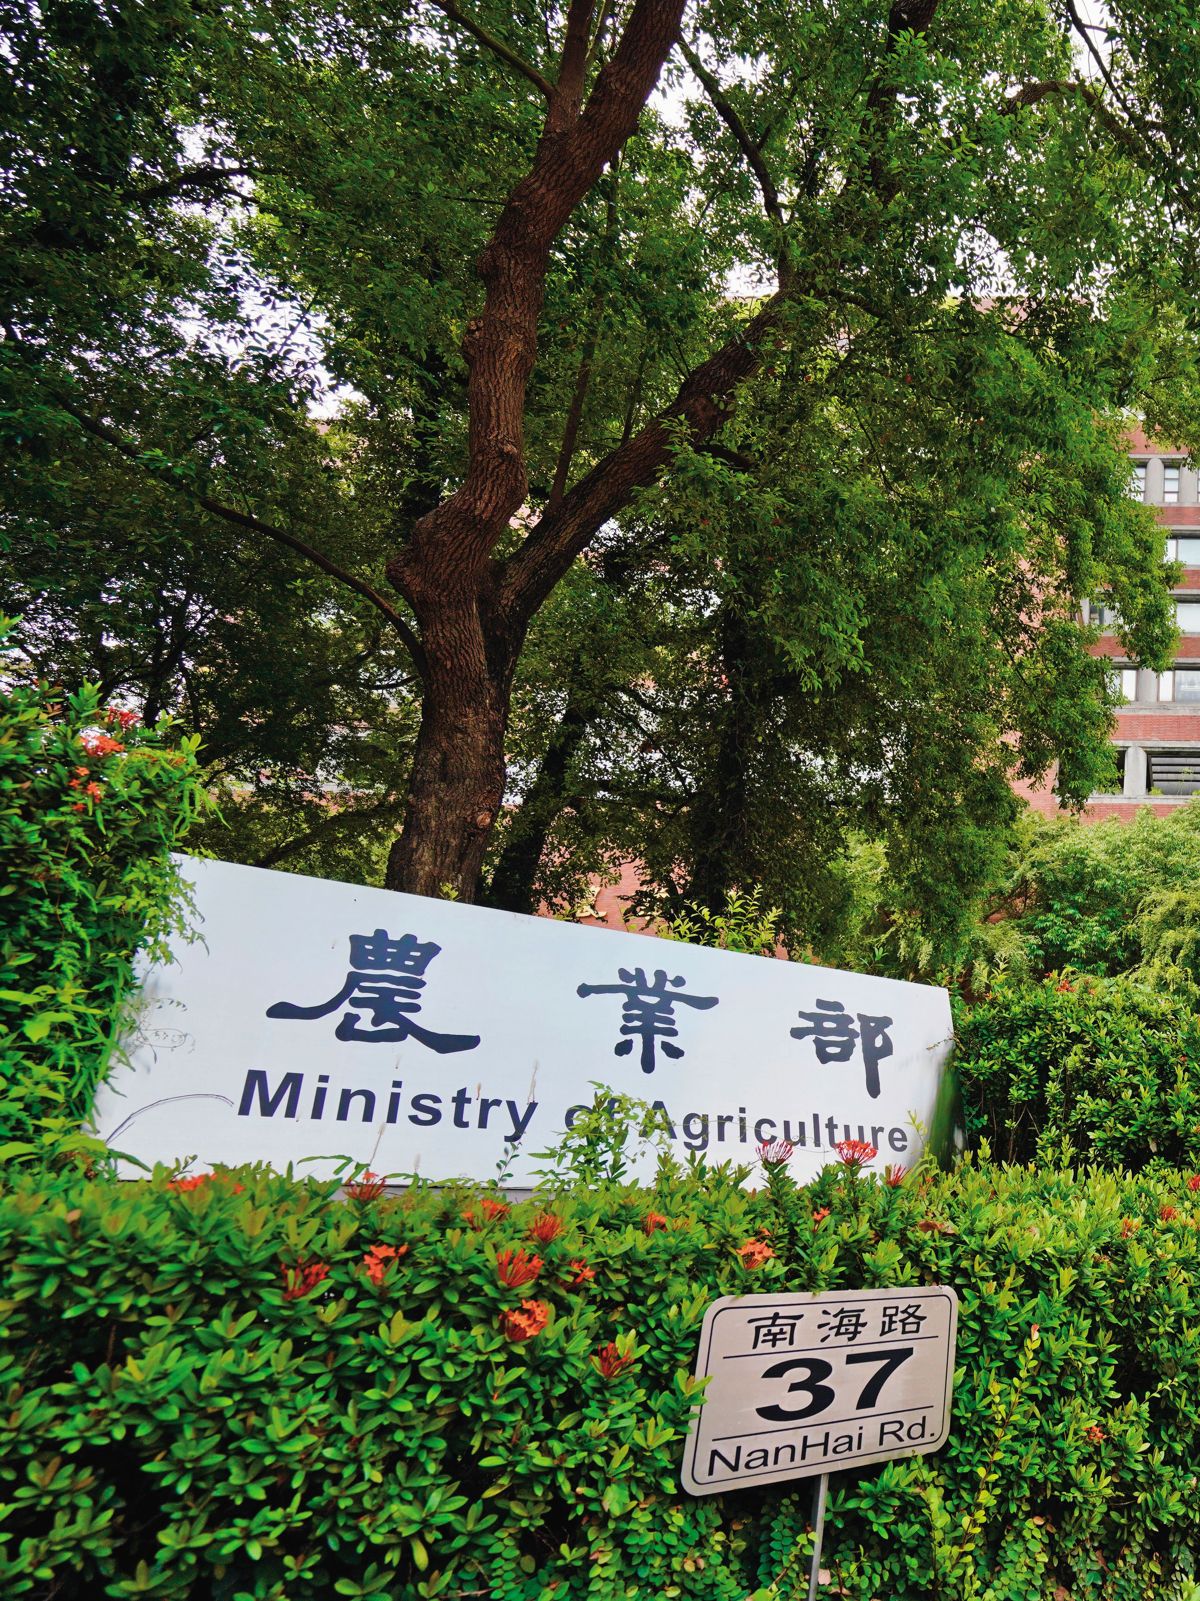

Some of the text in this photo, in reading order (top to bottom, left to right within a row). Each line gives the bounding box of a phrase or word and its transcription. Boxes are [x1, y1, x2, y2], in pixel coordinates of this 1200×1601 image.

[266, 928, 894, 1099] 農業部
[237, 1069, 539, 1143] Ministry
[638, 1100, 908, 1153] Agriculture
[747, 1304, 928, 1350] 南海路
[755, 1347, 914, 1422] 37
[707, 1416, 936, 1477] NanHai Rd.
